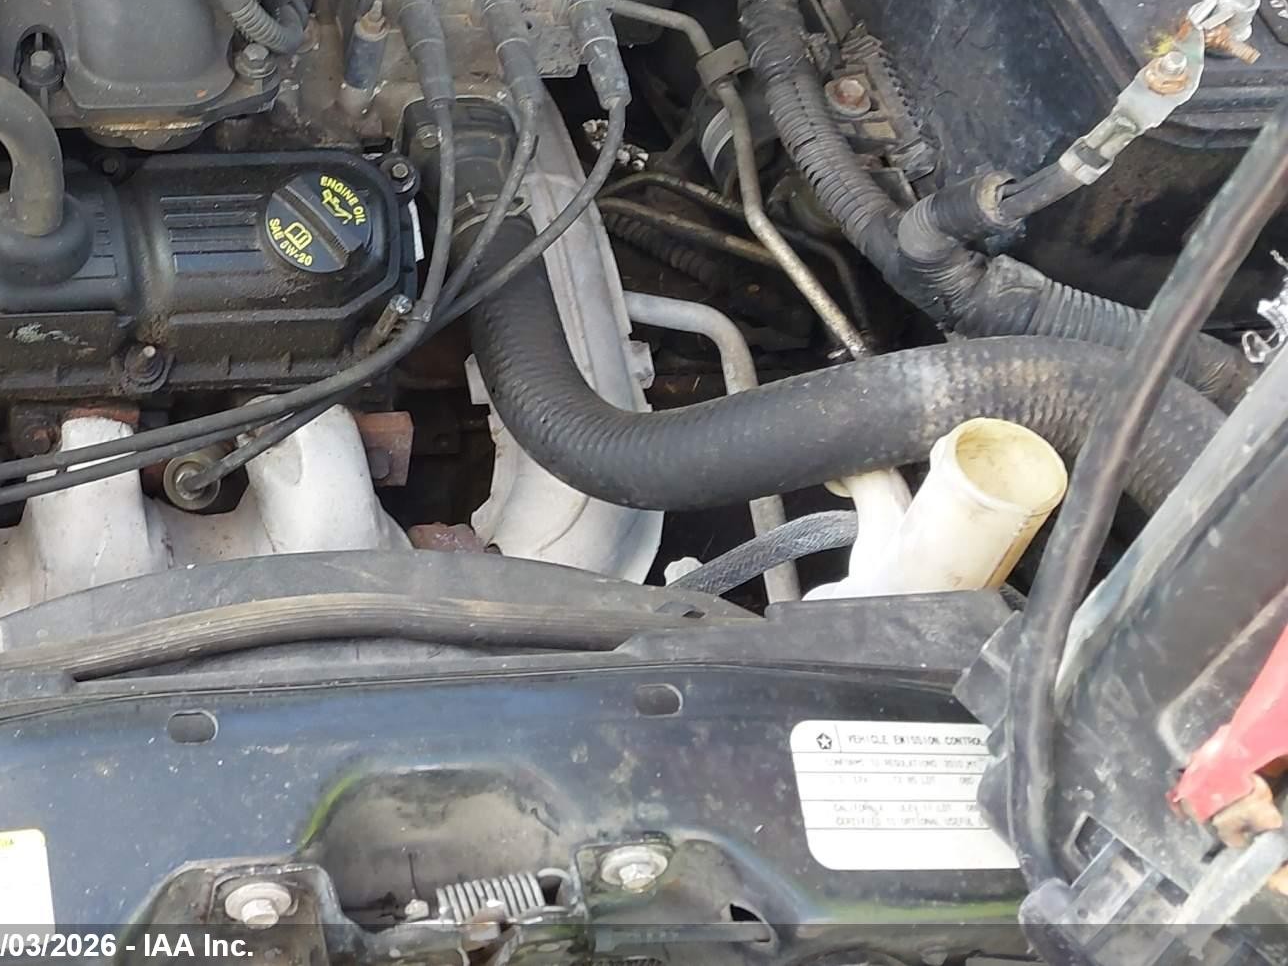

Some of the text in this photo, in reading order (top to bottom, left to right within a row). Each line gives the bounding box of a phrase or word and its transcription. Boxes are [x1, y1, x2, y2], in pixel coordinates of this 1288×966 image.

[320, 176, 366, 225] ENGINE OIL
[269, 218, 285, 240] SAE
[894, 735, 941, 746] EMISSION
